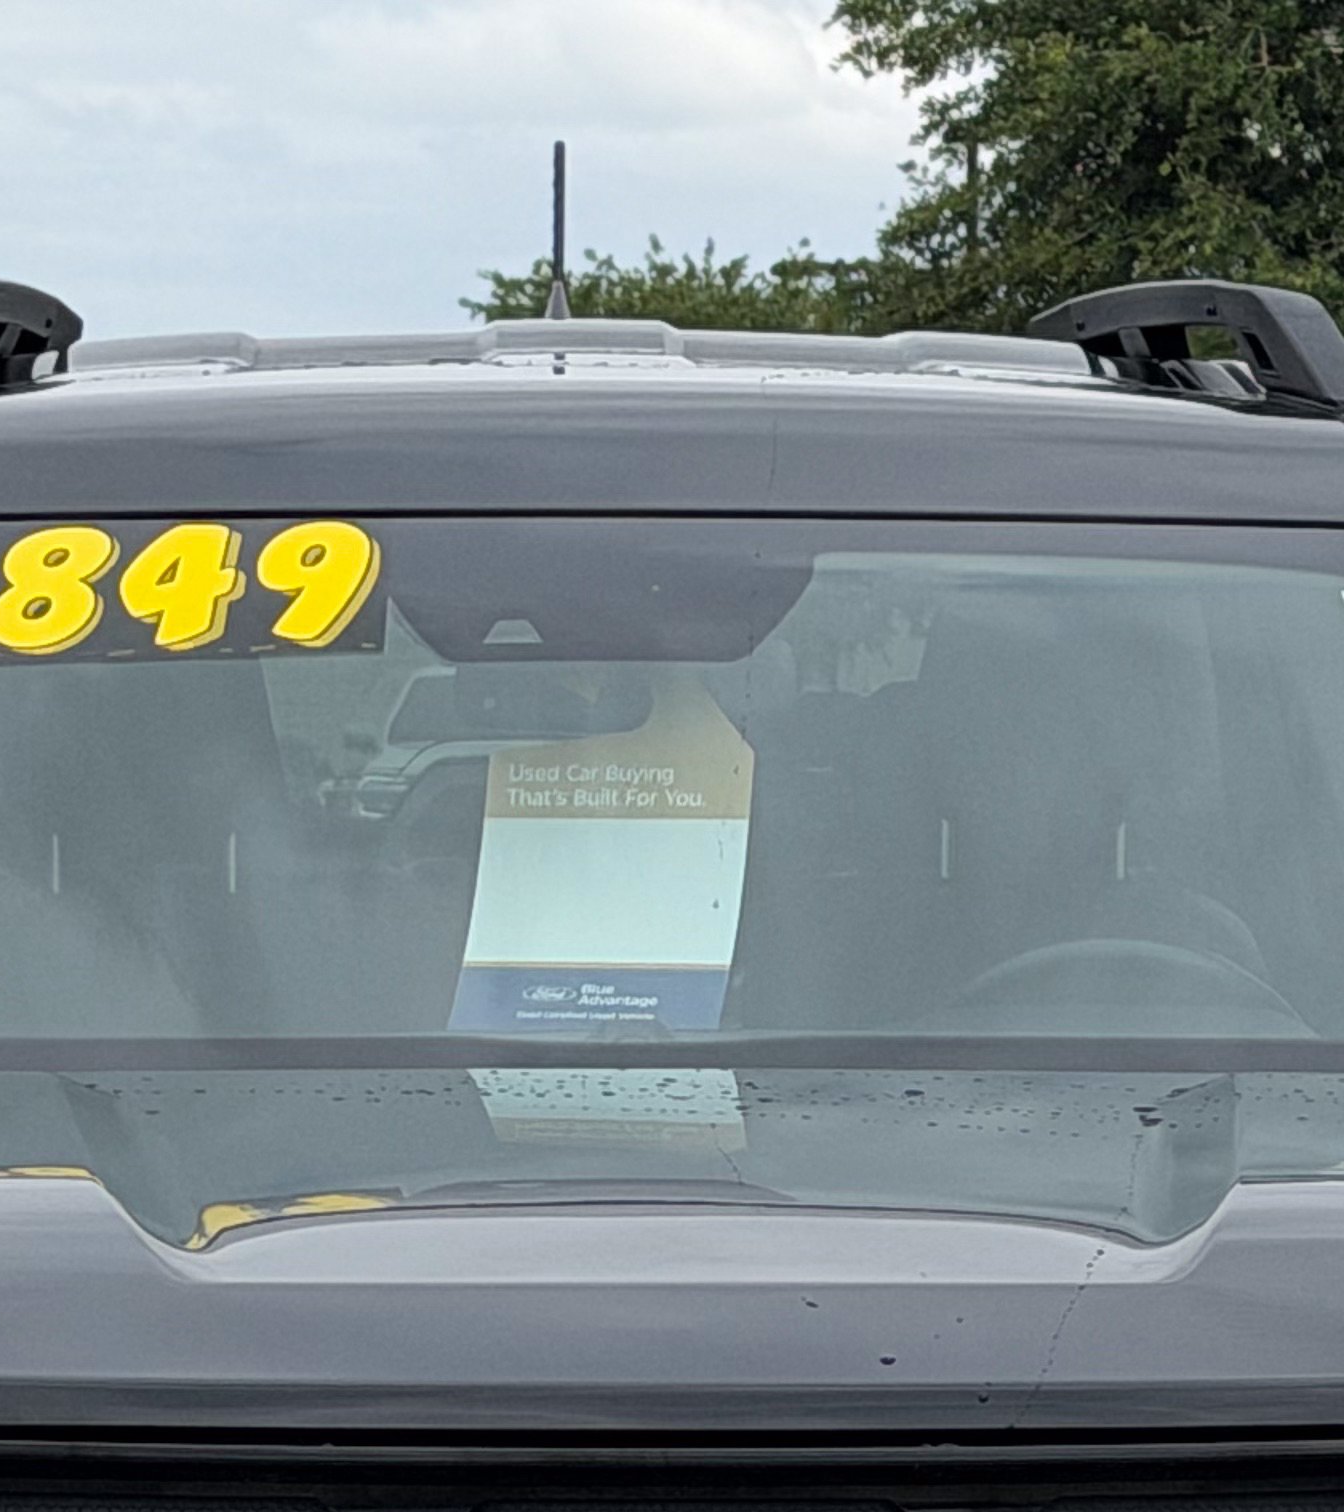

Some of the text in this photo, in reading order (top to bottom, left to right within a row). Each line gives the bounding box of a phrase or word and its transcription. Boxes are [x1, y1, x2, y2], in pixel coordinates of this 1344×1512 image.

[508, 764, 674, 786] Used Car Buying
[507, 788, 706, 807] That's Built For You.
[578, 994, 659, 1009] Advantage
